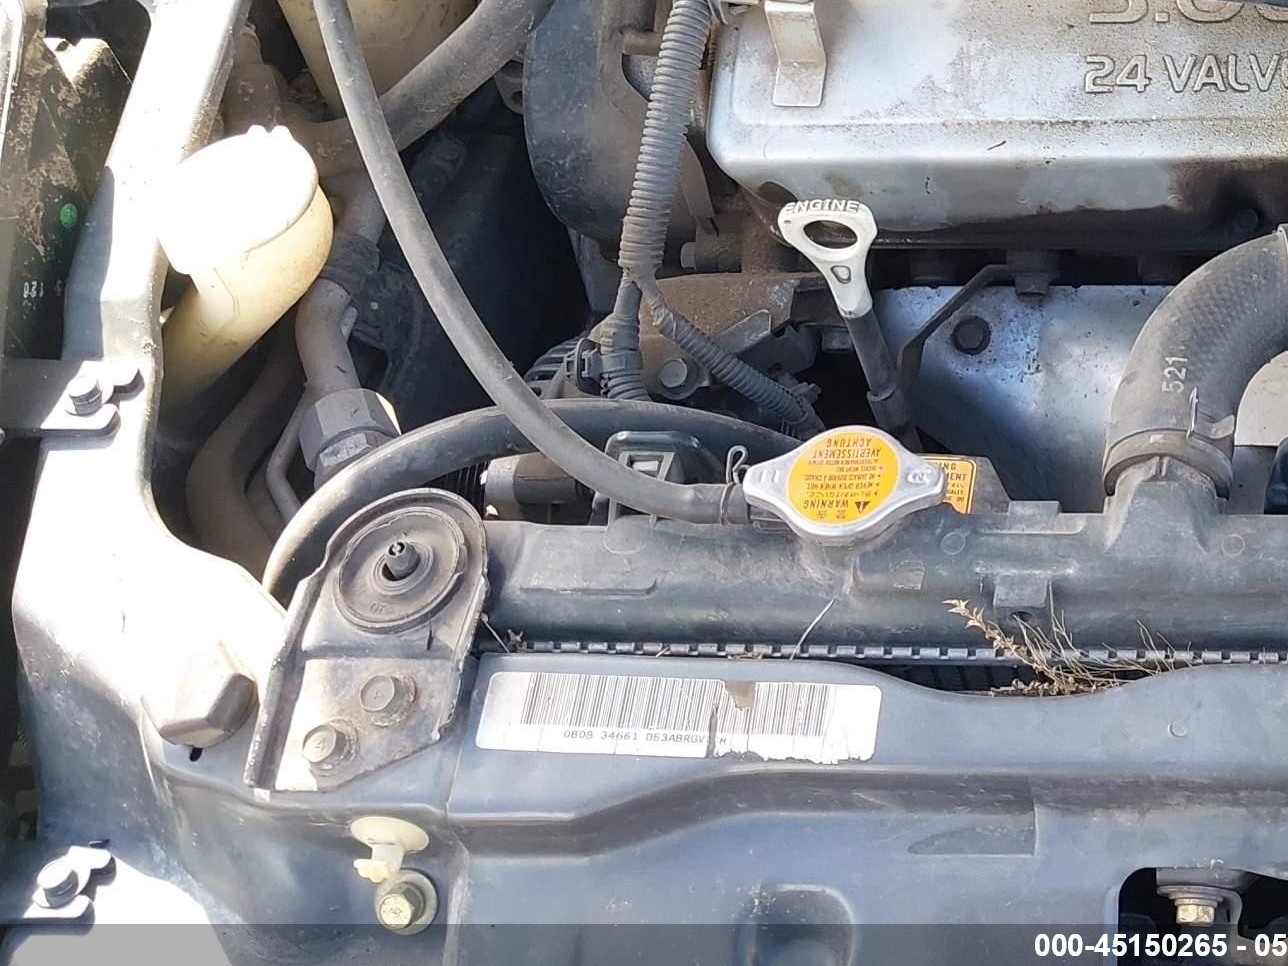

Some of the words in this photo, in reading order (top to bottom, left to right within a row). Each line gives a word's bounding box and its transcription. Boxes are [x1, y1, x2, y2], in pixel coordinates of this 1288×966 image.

[1084, 54, 1152, 94] 24
[783, 199, 860, 213] ENGINE
[1161, 357, 1189, 394] 521
[826, 438, 872, 448] ACHTUNG
[813, 449, 882, 458] AVERTISSEMENT
[803, 499, 849, 509] WARNING
